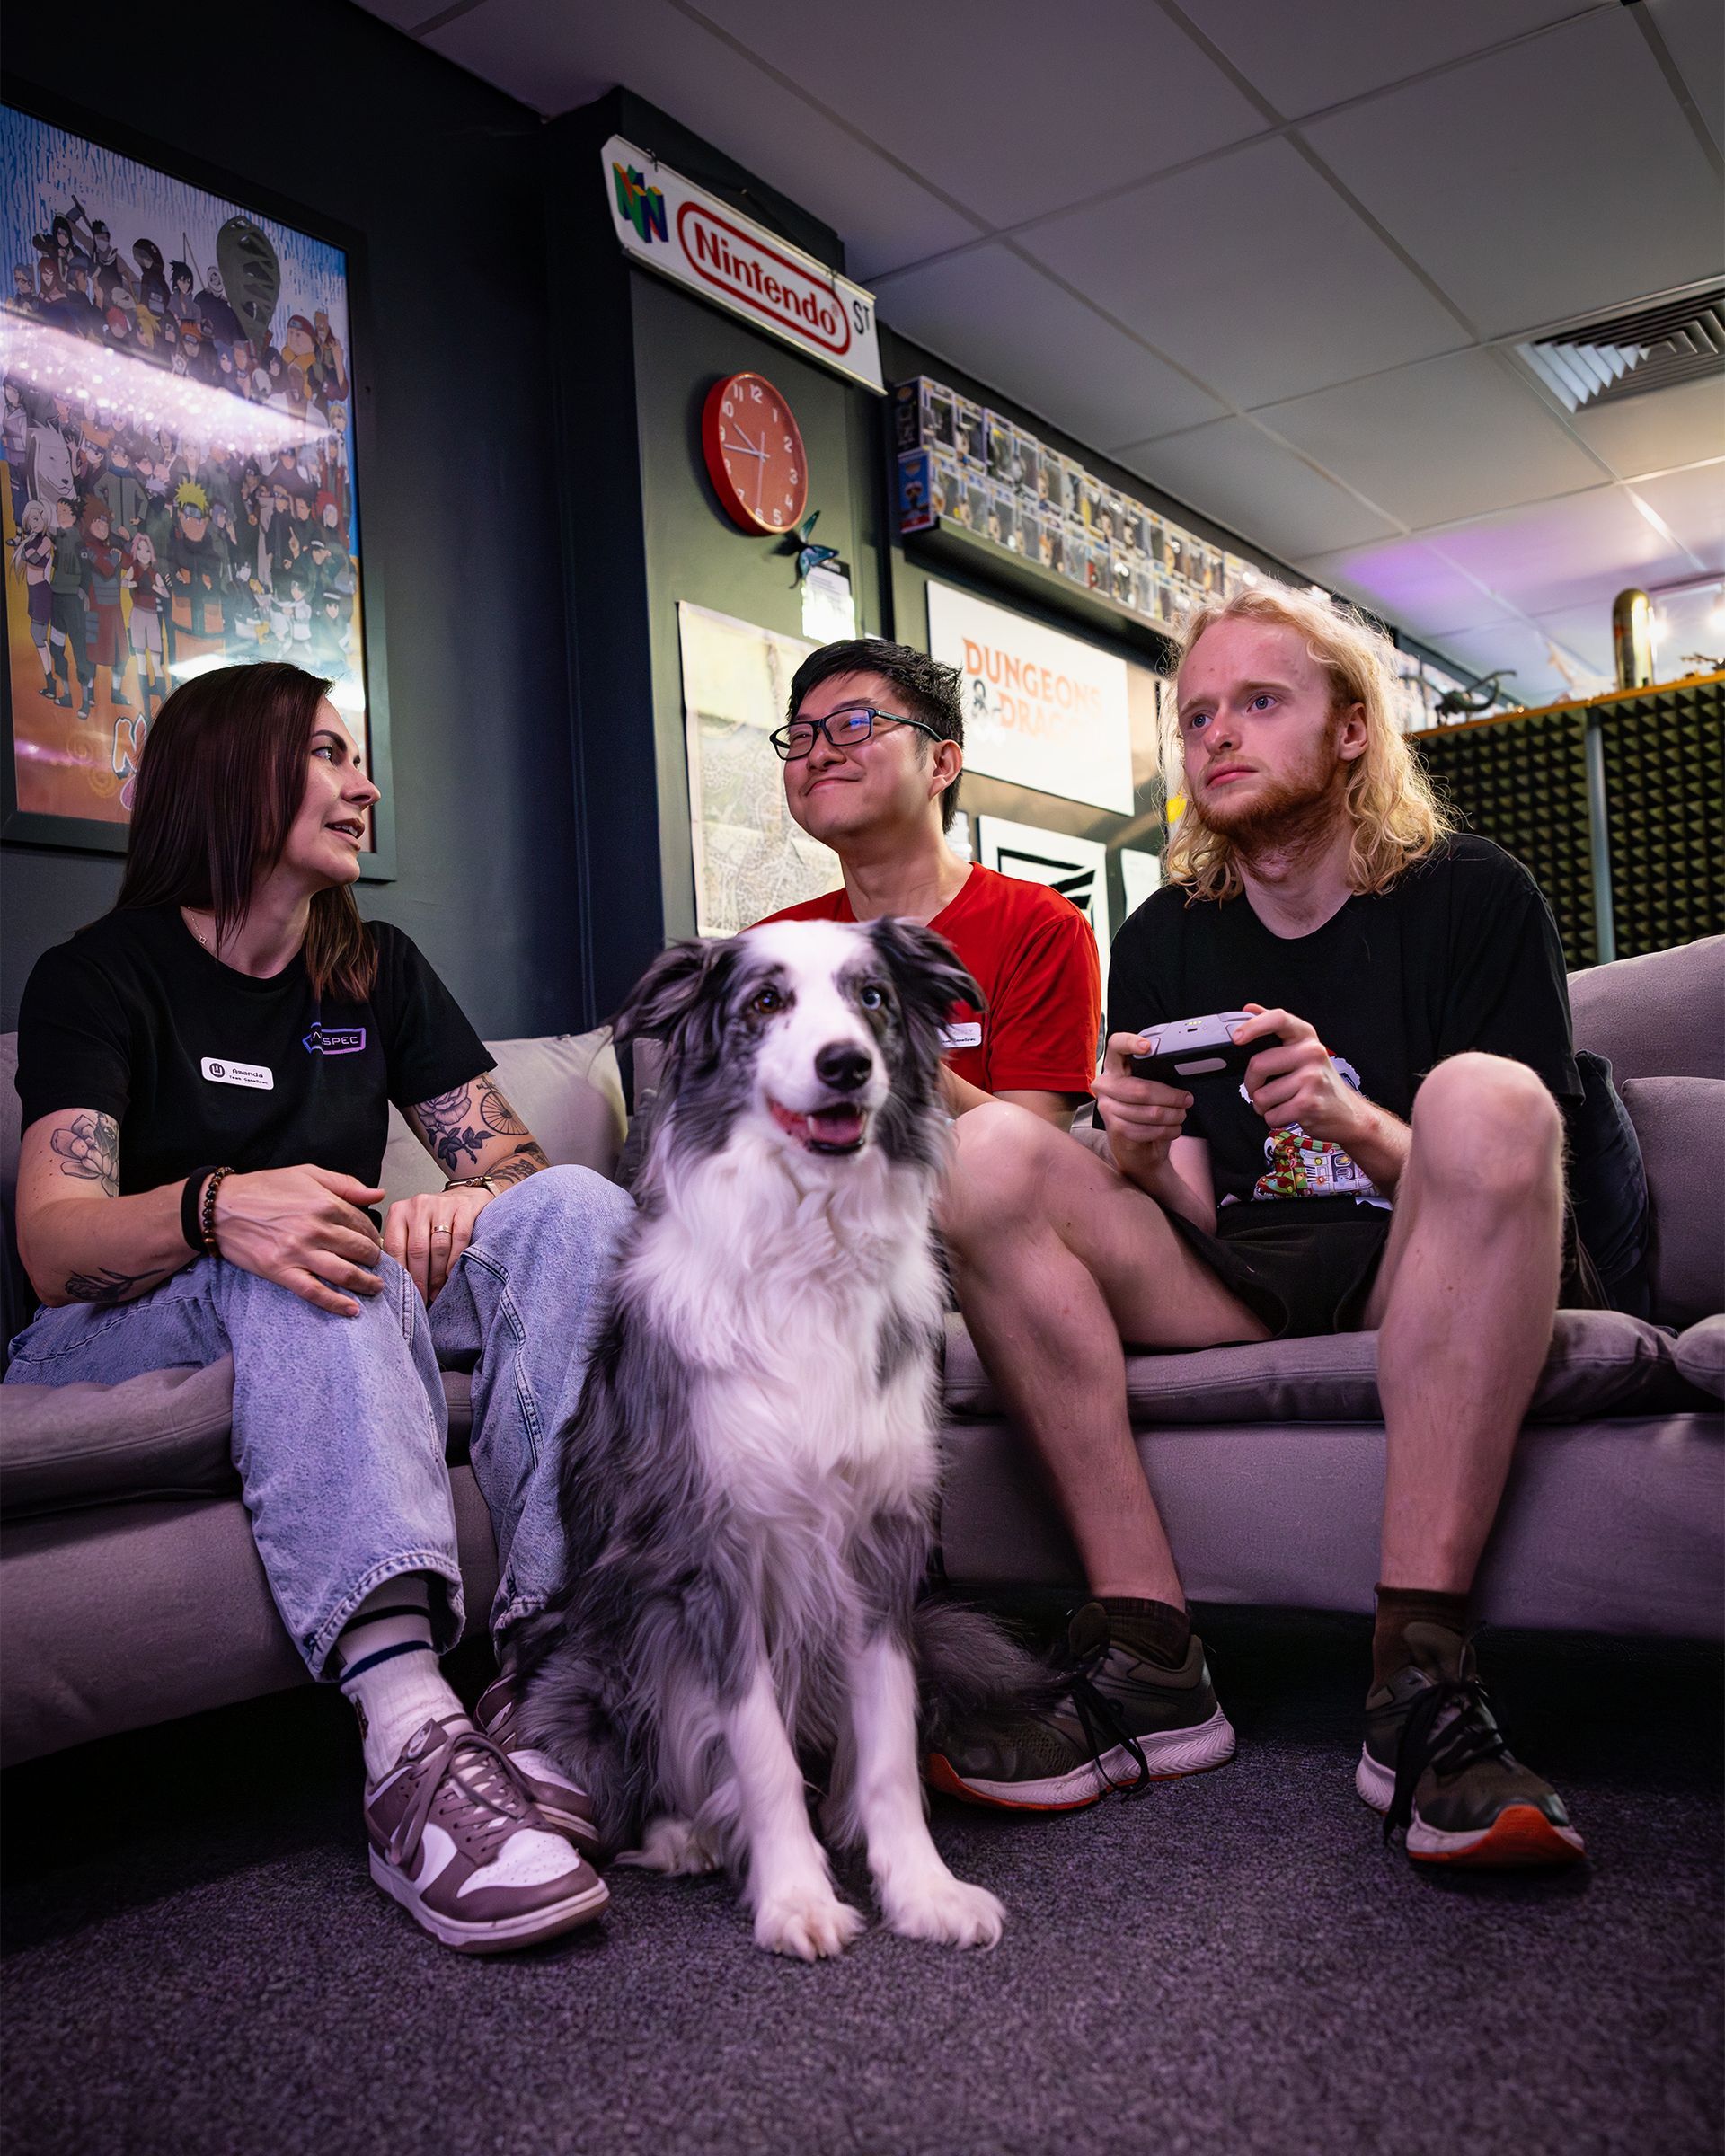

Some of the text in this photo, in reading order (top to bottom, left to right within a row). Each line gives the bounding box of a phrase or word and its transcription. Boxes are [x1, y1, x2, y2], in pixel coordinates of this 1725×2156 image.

[694, 221, 836, 336] Nintendo
[853, 299, 871, 335] ST
[733, 384, 763, 403] 11 12
[721, 401, 734, 418] 10
[772, 408, 778, 423] 1
[783, 435, 792, 453] 2
[789, 468, 798, 485] 3
[784, 494, 793, 511] 4
[773, 508, 783, 526] 5
[962, 634, 1102, 715] DUNGEONS
[232, 1067, 264, 1079] Amanda
